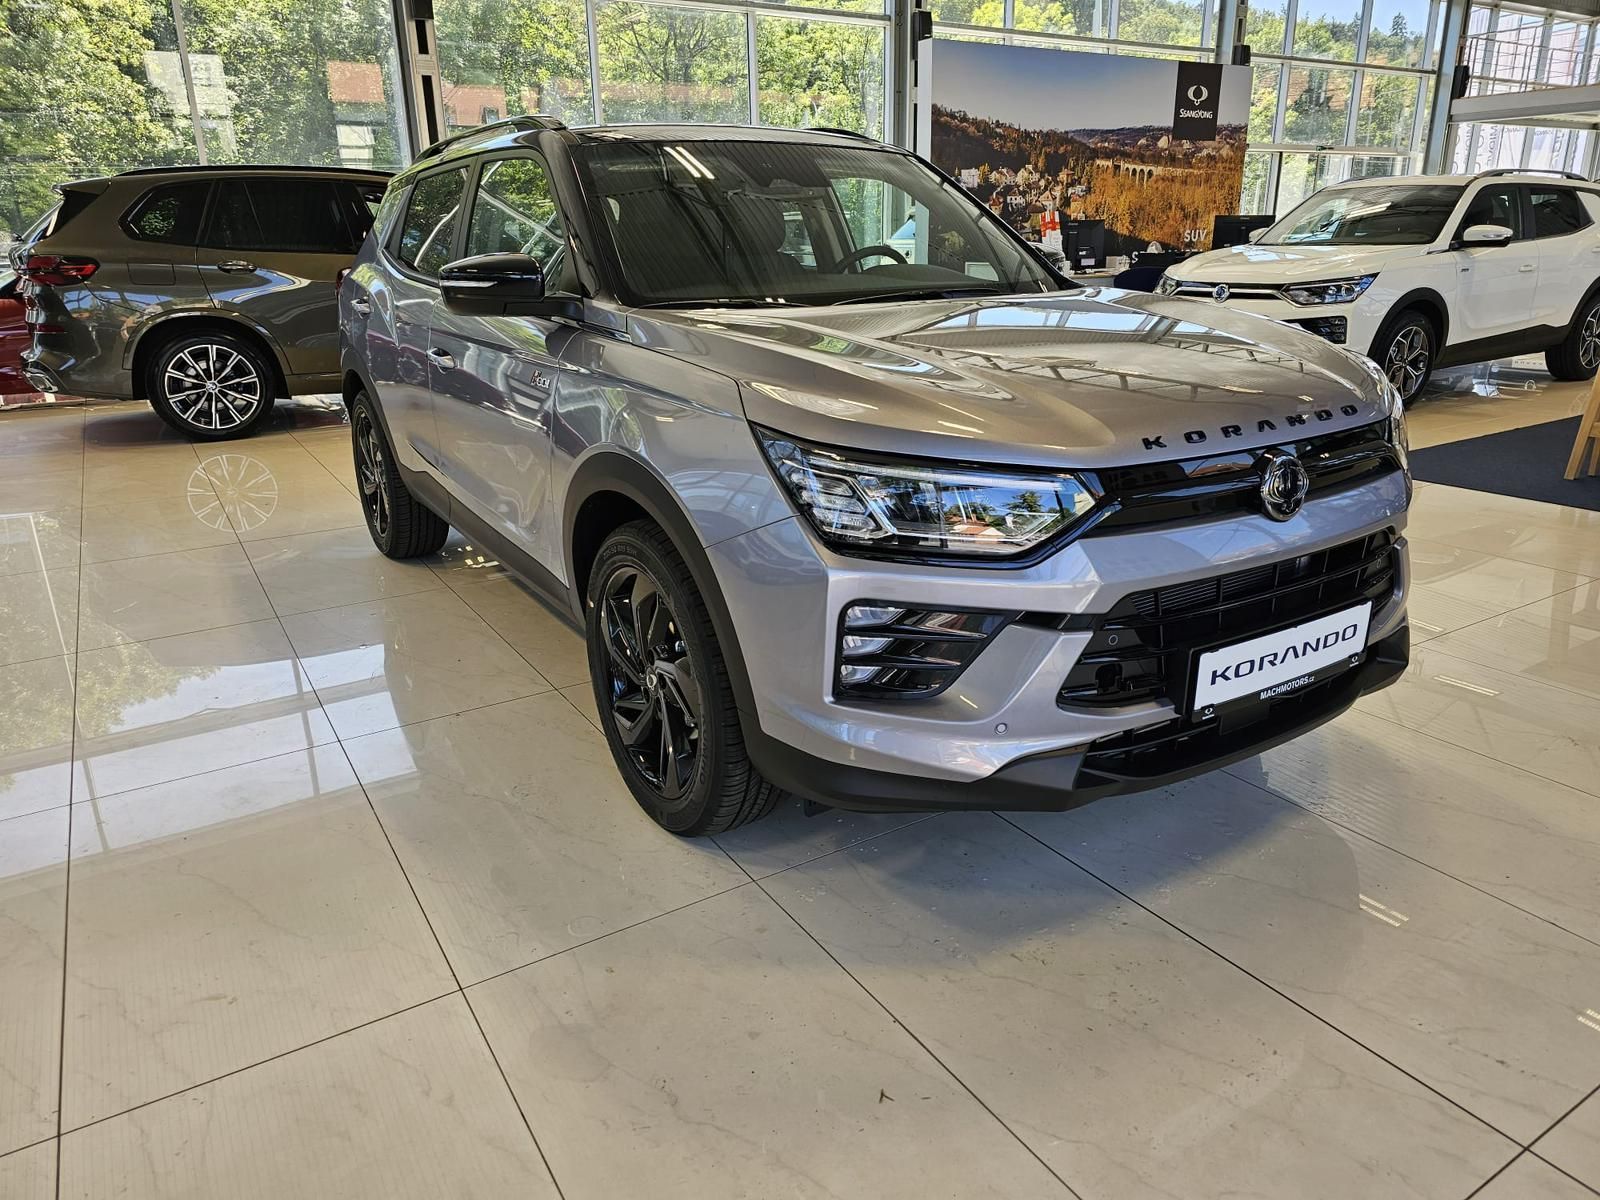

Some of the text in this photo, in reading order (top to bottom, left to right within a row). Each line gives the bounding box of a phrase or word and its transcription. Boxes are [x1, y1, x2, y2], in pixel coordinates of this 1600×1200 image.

[1183, 229, 1208, 242] SUV
[1141, 404, 1359, 450] KORANDO
[1210, 623, 1358, 686] KORANDO
